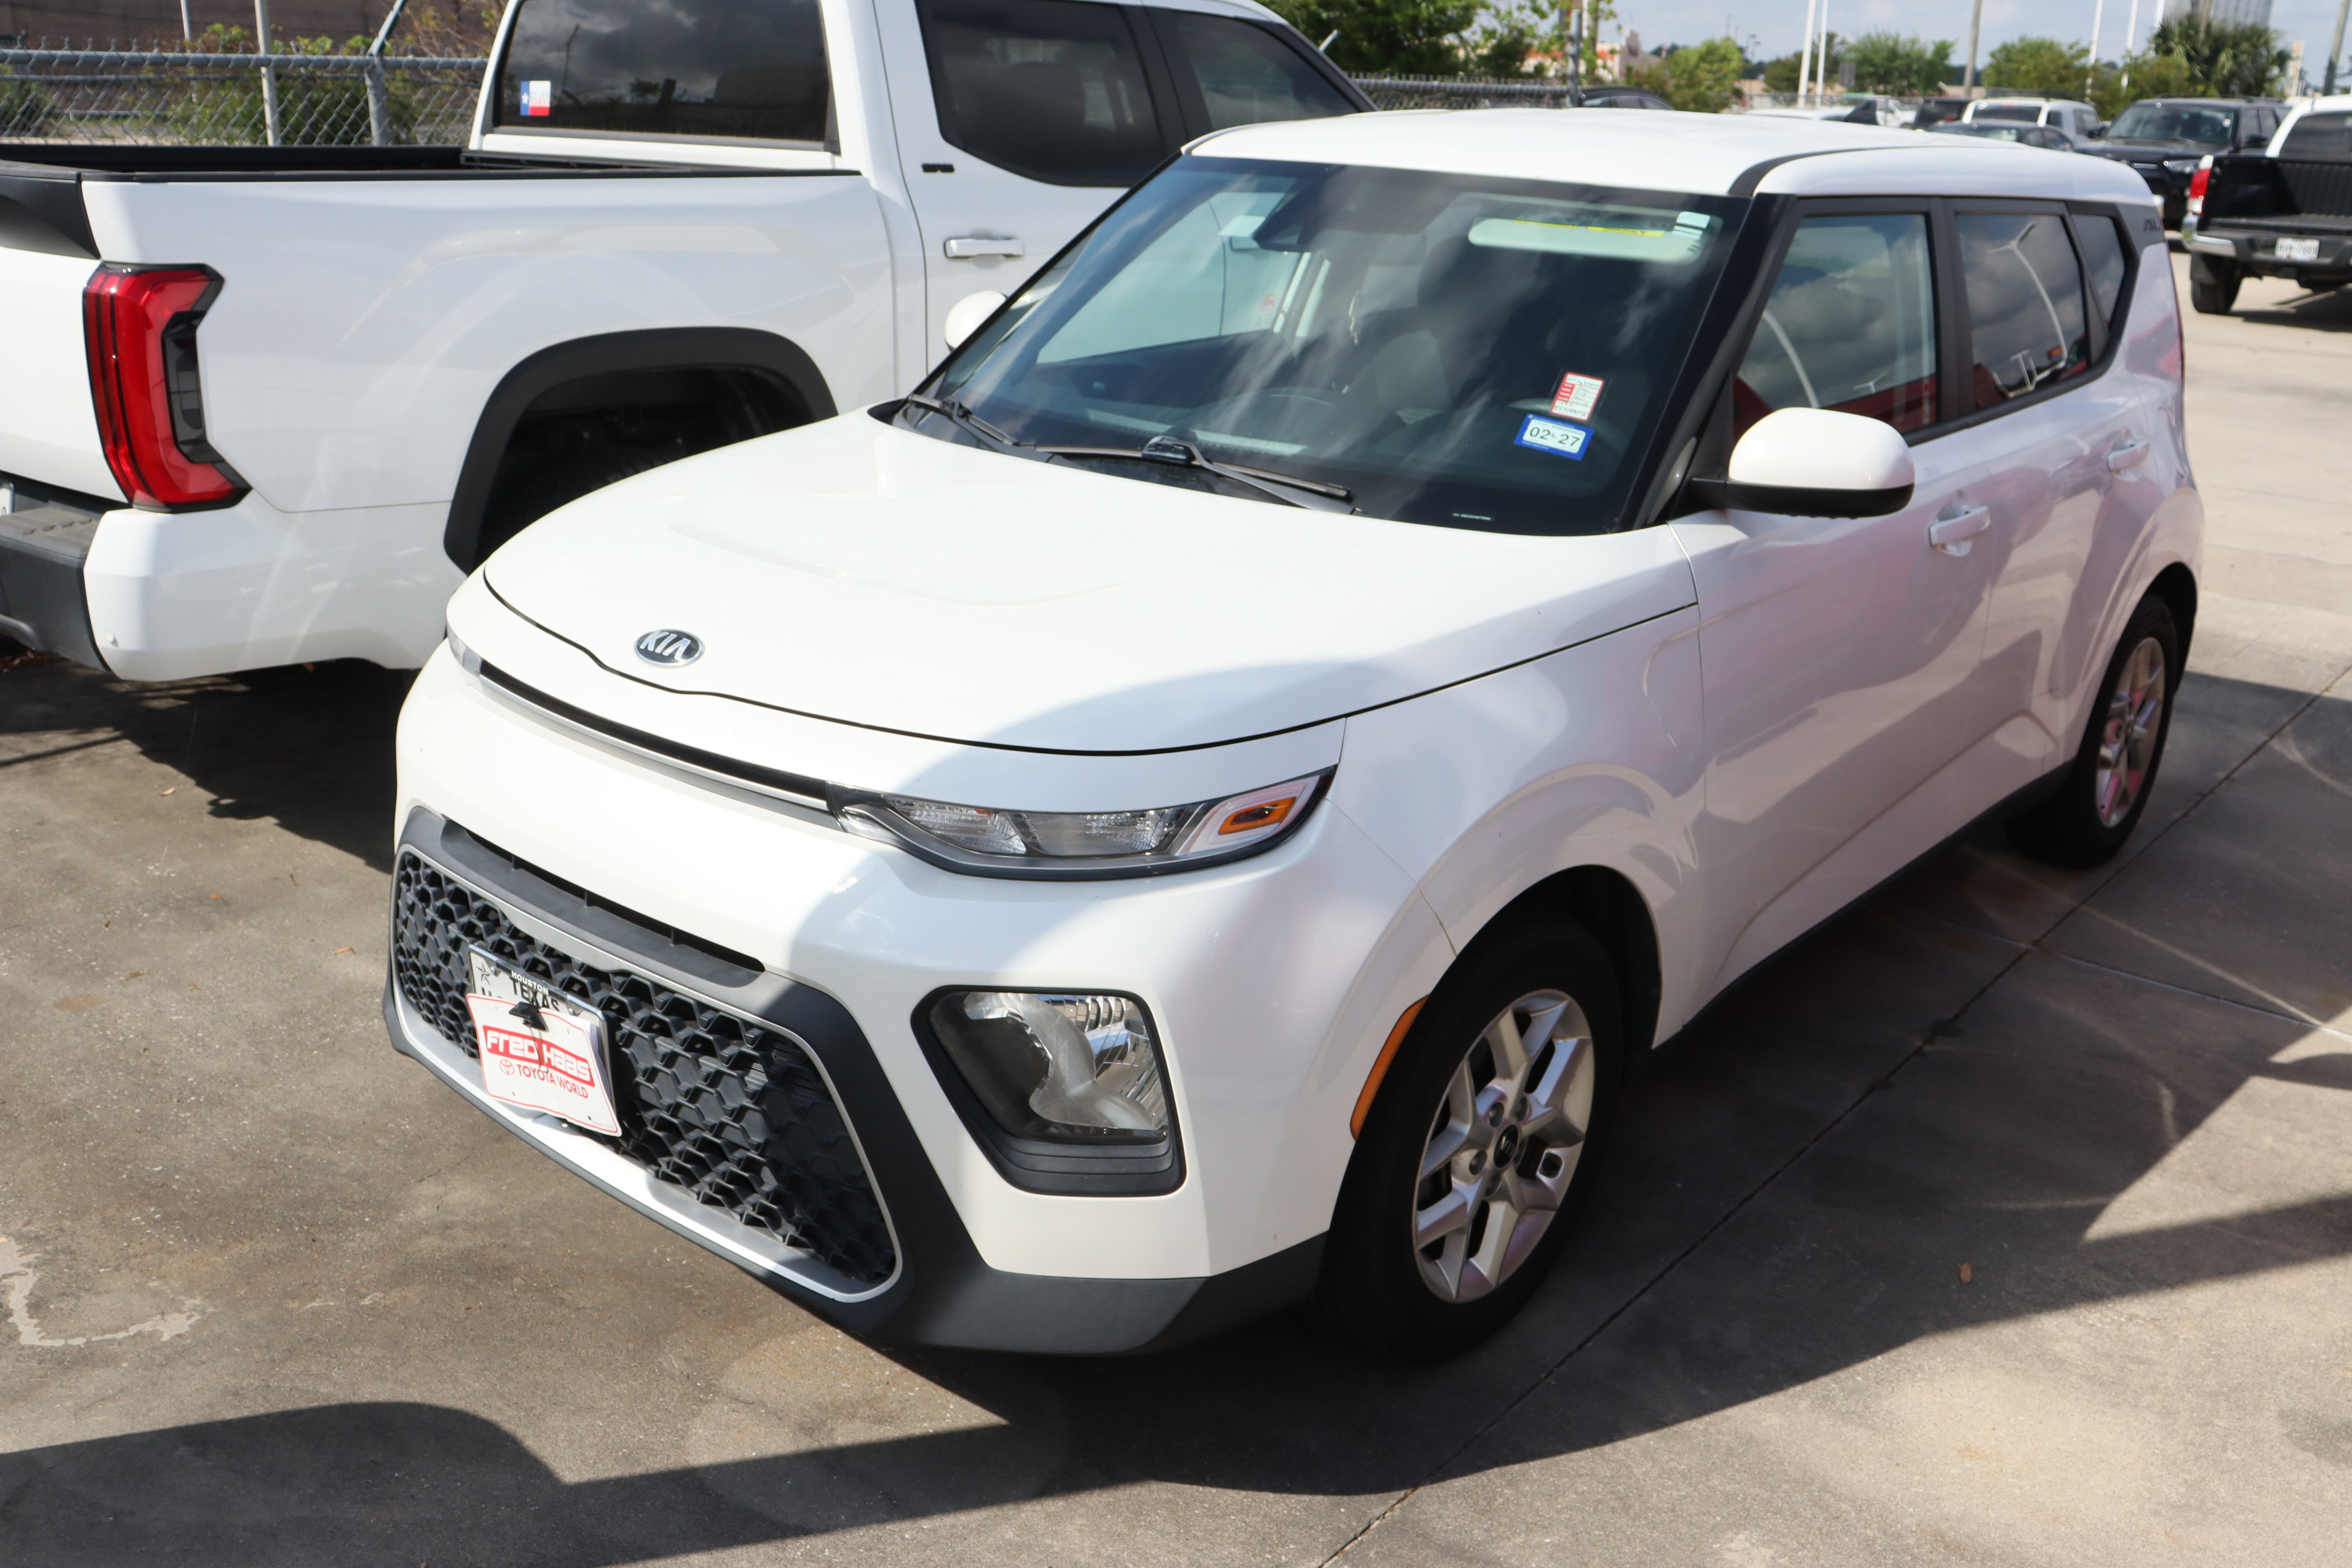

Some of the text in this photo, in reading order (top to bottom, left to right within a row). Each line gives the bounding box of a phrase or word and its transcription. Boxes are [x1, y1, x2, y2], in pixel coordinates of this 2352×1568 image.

[639, 631, 691, 661] KIA
[511, 970, 549, 995] HOUSTON
[517, 1064, 589, 1099] TOYOTA WORLD
